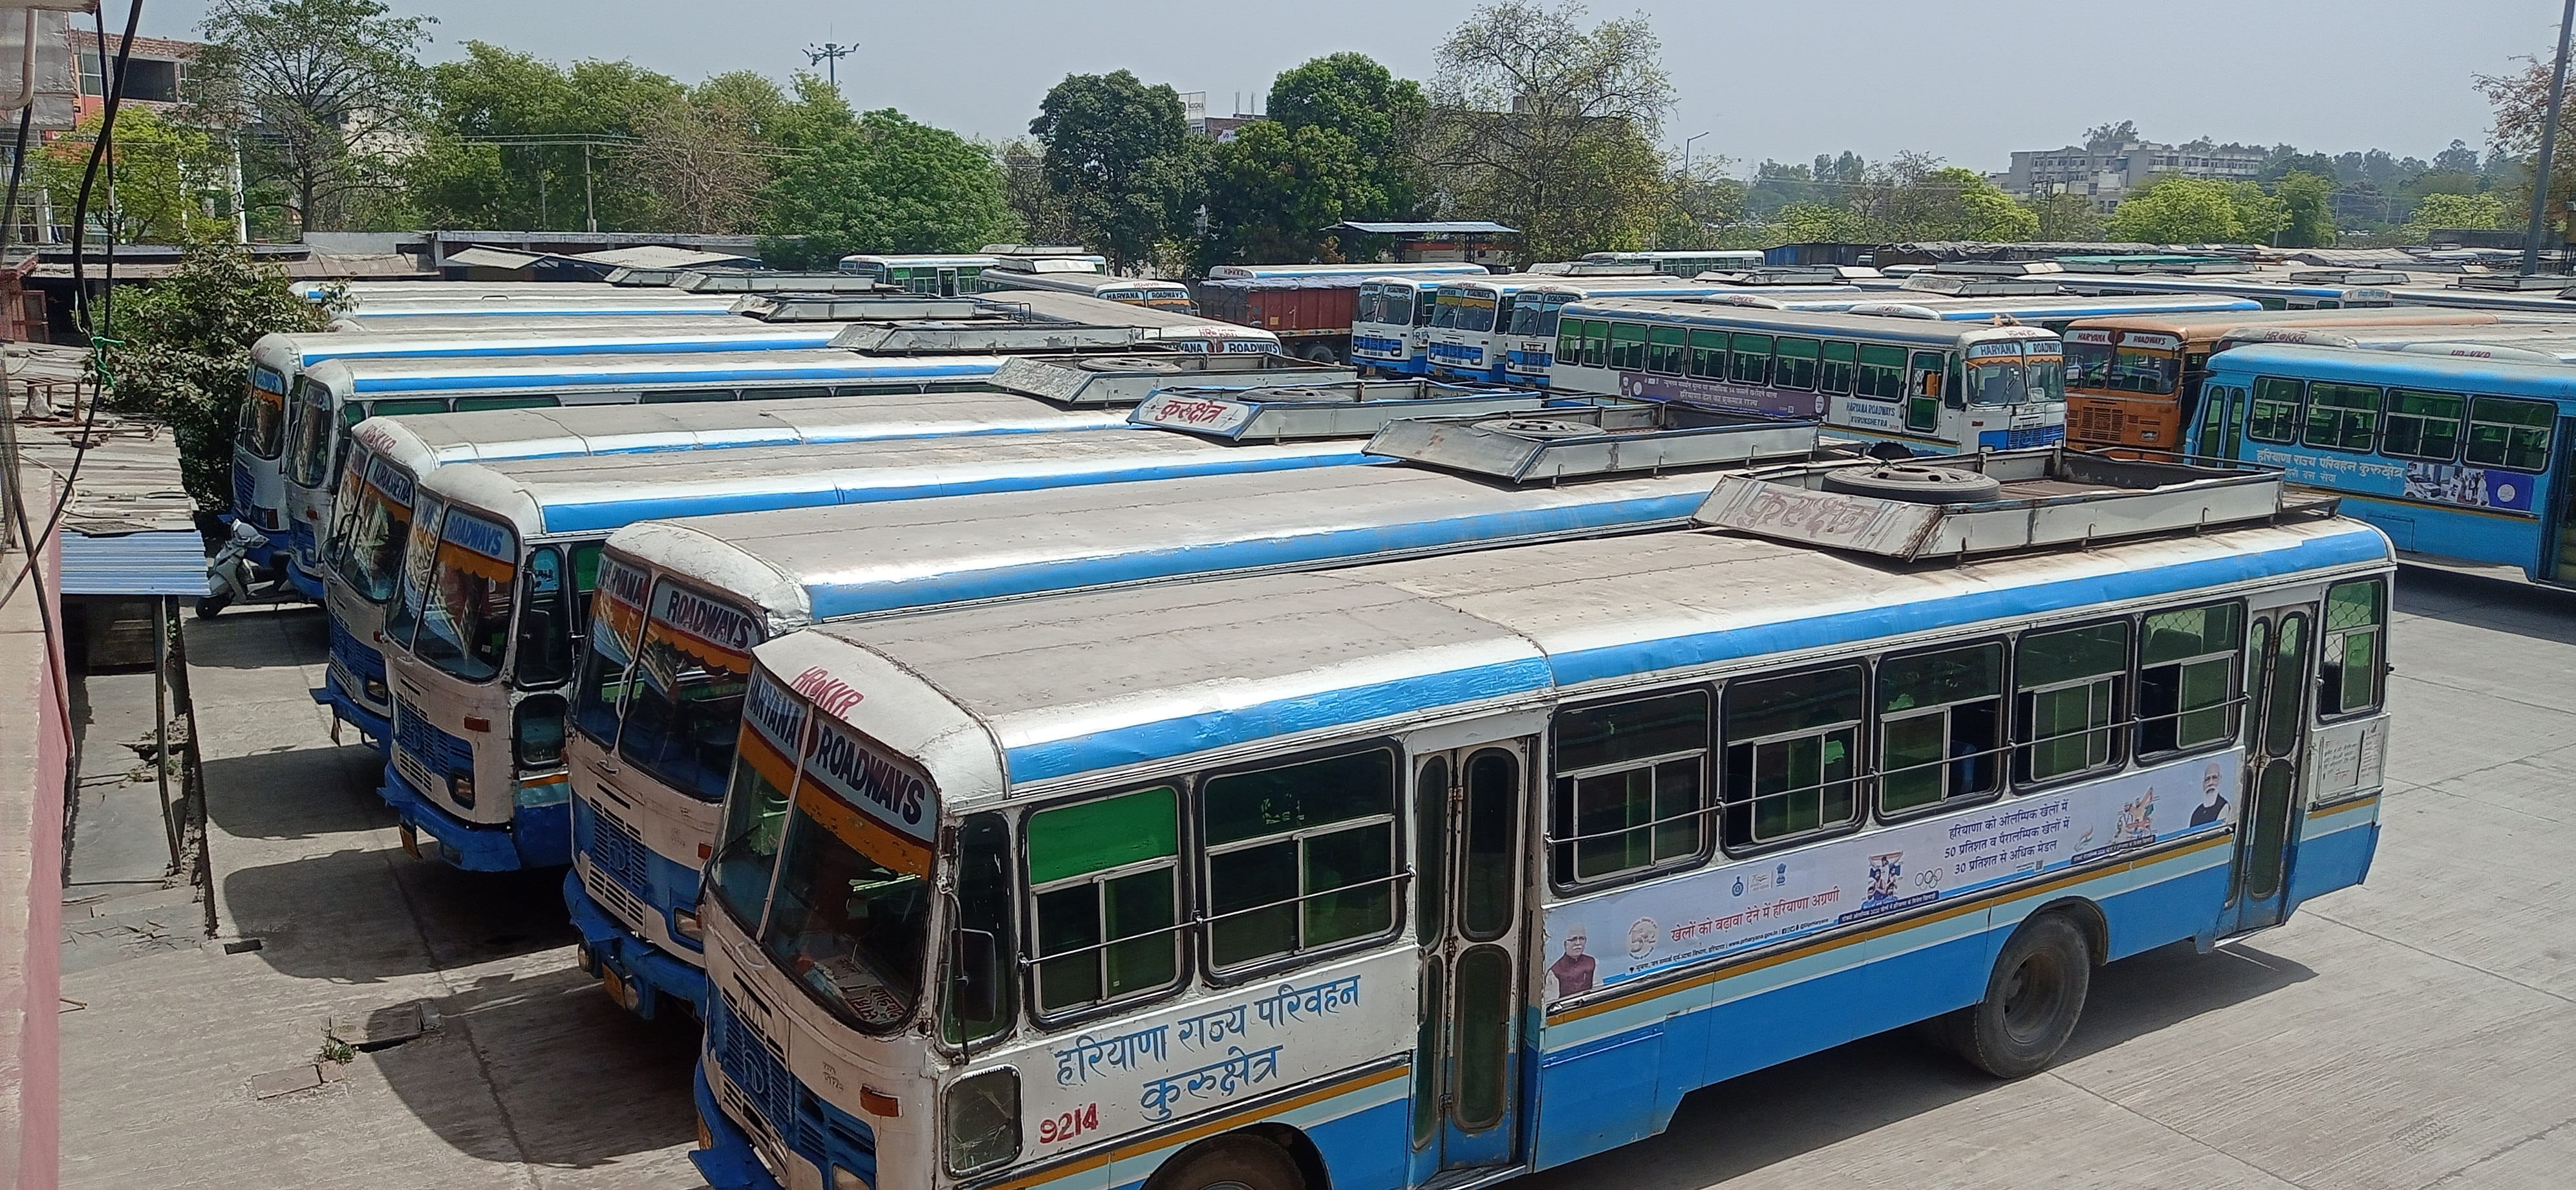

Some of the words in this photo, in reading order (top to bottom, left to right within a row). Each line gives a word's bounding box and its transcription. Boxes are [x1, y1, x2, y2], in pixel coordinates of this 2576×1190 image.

[1106, 292, 1140, 301] HARYANA
[1229, 342, 1278, 354] ROADWAYS
[1980, 343, 2017, 356] HARYANA
[2033, 342, 2061, 354] ROADWAYS
[2077, 332, 2106, 342] HARYANA
[2133, 335, 2167, 345] ROADWAYS
[1846, 401, 1867, 414] HARYANA
[1867, 404, 1896, 416] ROADWAYS
[1851, 415, 1888, 427] KURUKSHETRA
[2256, 448, 2292, 464] हरियाणा
[2293, 453, 2317, 468] राज्य
[2319, 455, 2357, 475] परिवहन
[447, 515, 504, 556] ROADWAYS
[667, 589, 753, 649] ROADWAYS
[746, 670, 801, 750] HARYANA
[815, 723, 927, 825] ROADWAYS
[1944, 847, 1956, 859] 50
[1959, 839, 1987, 855] प्रतिशत
[1989, 836, 1997, 847] व
[2041, 819, 2061, 835] खेलों
[1949, 823, 1983, 840] हरियाणा
[1985, 816, 1997, 830] को
[2039, 801, 2059, 817] खेलों
[2061, 799, 2069, 812] में
[1955, 863, 1966, 875] 30
[1969, 855, 1997, 871] प्रतिशत
[1999, 849, 2008, 863] से
[2010, 845, 2035, 861] अधिक
[1670, 920, 1696, 942] खेलों
[1699, 916, 1713, 935] को
[1715, 913, 1744, 933] बढ़ावा
[1746, 905, 1761, 925] देने
[1763, 902, 1771, 918] में
[1773, 898, 1810, 919] हरियाणा
[1812, 885, 1841, 907] अग्रणी
[1053, 1024, 1170, 1087] हरियाणा
[1177, 1003, 1247, 1054] राज्य
[1254, 973, 1362, 1030] परिवहन
[1139, 1044, 1285, 1123] कुरुक्षेत्र
[1038, 1102, 1099, 1144] 9214
